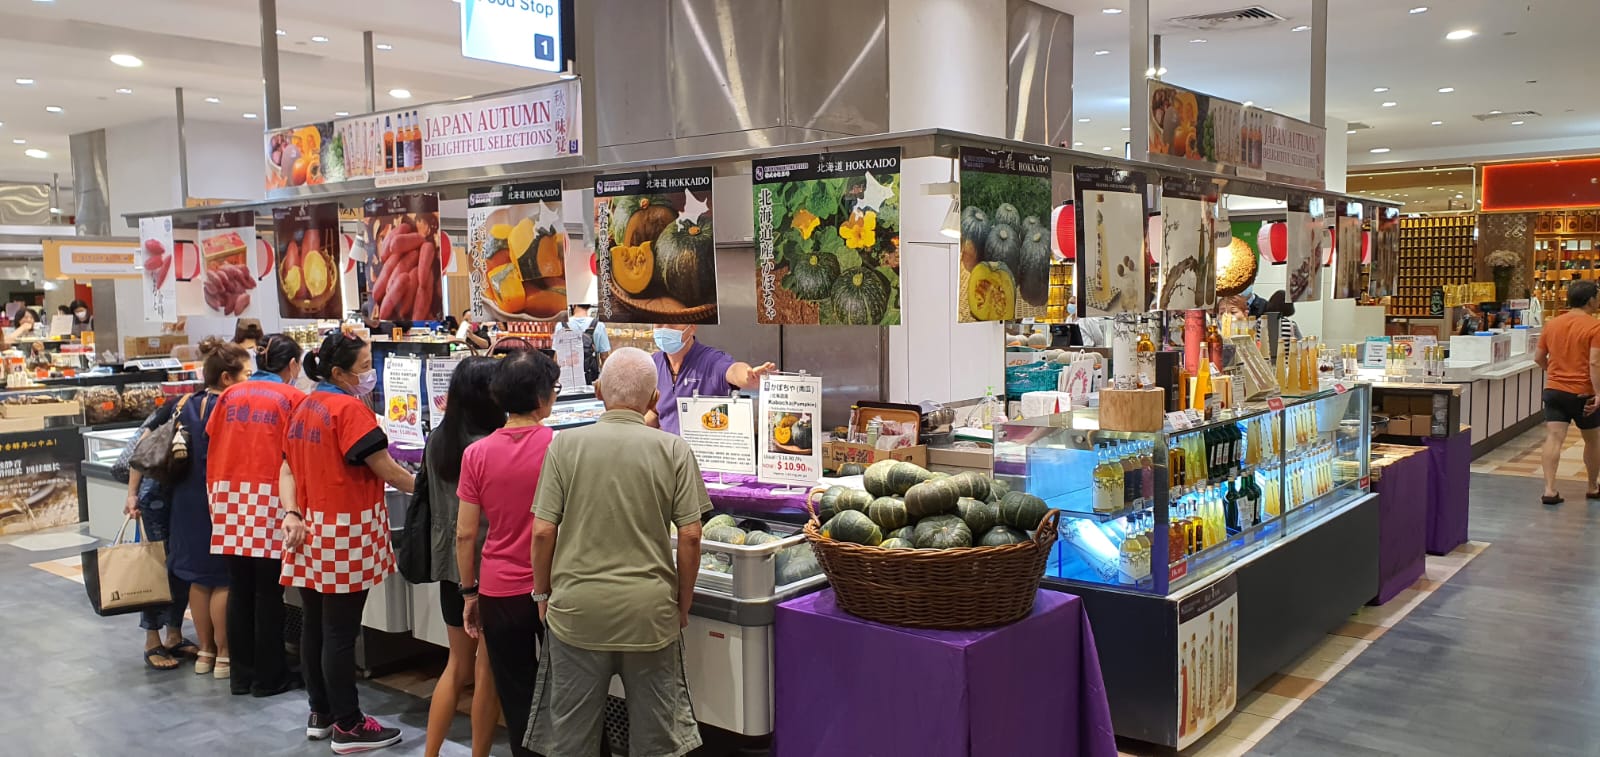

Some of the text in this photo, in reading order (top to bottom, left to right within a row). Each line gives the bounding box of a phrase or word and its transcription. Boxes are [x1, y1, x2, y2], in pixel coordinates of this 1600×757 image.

[520, 0, 553, 18] Stop
[541, 40, 549, 56] 1
[424, 101, 551, 142] JAPAN AUTUMN
[424, 128, 552, 157] DELIGHTFUL SELECTIONS
[1264, 124, 1286, 146] JAPAN
[817, 161, 844, 173] 北海道
[845, 157, 897, 171] HOKKAIDO
[1018, 162, 1049, 173] HOKKAIDO
[646, 178, 668, 189] 北海道
[668, 176, 710, 187] HOKKAIDO
[526, 188, 560, 199] HOKKAIDO
[759, 188, 776, 320] 北海道産かぼちゃ
[777, 461, 782, 470] $
[784, 462, 806, 472] 10.90
